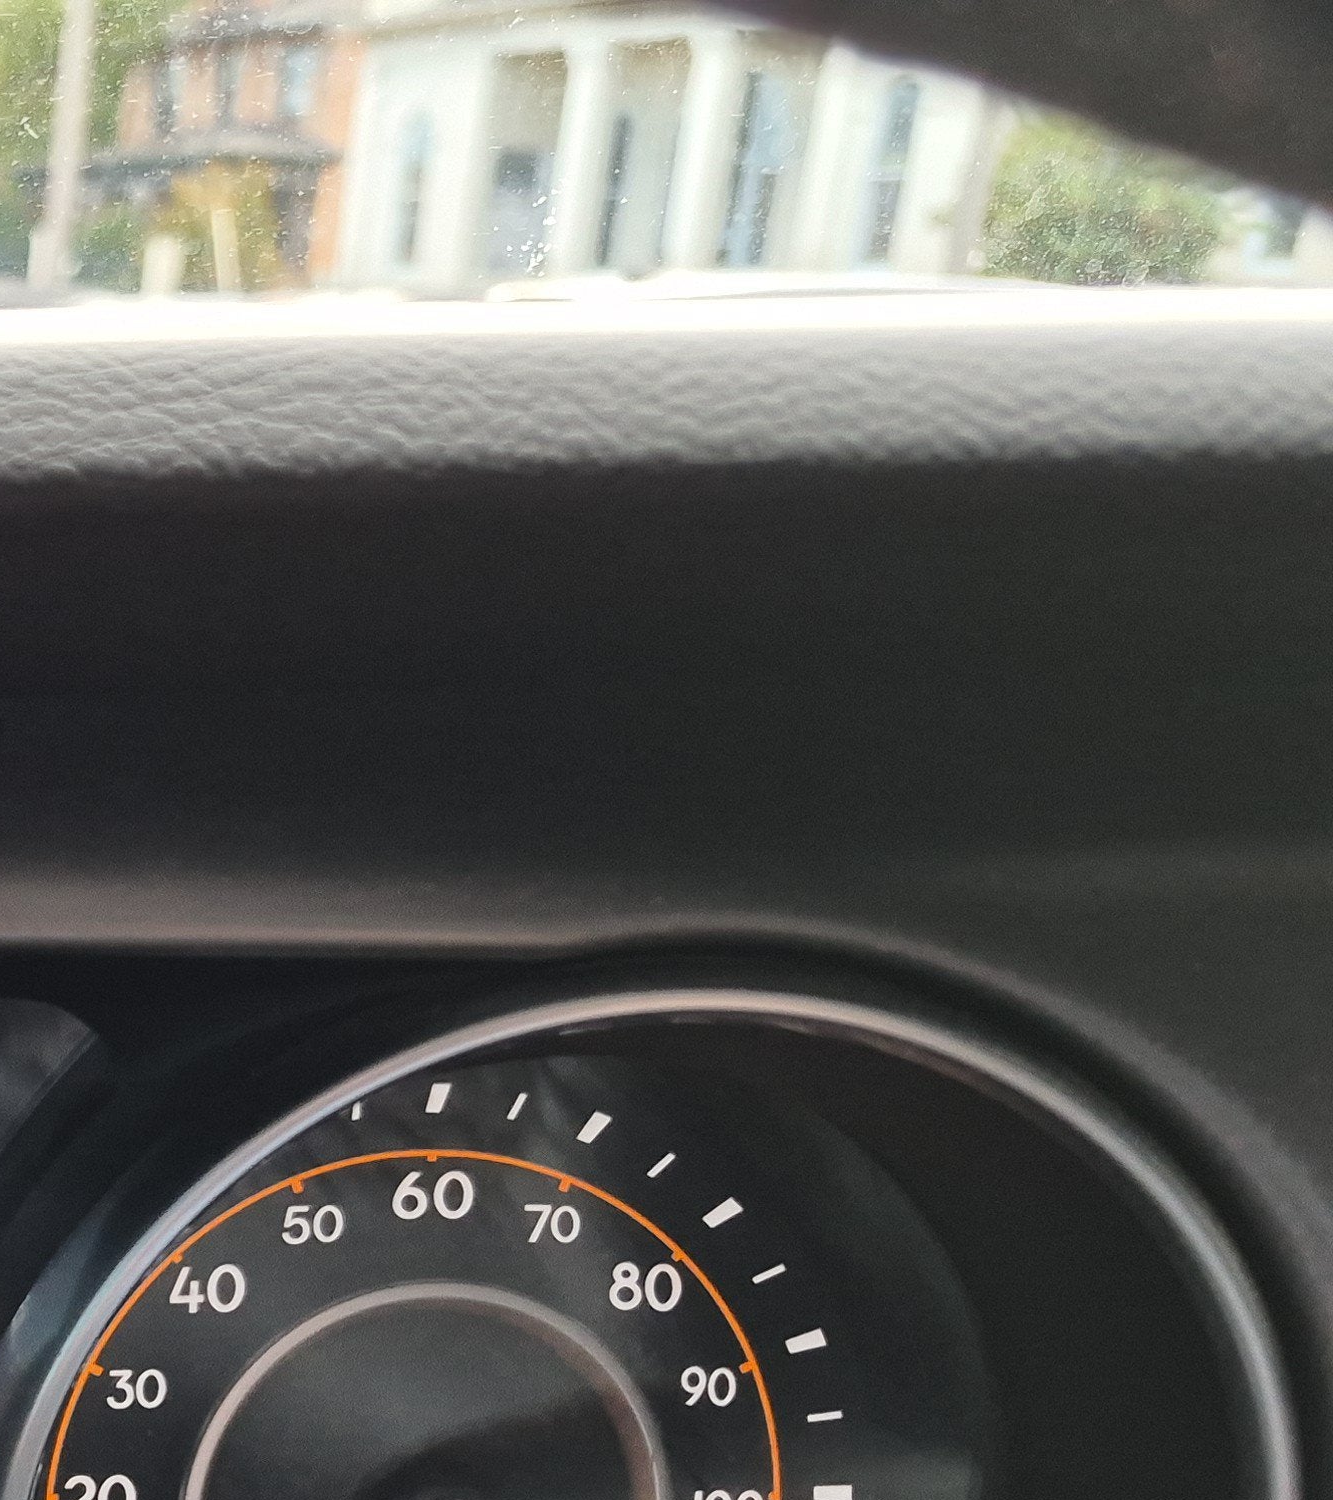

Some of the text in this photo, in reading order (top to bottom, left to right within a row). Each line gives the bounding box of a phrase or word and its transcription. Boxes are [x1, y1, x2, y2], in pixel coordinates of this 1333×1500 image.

[390, 1169, 477, 1221] 60
[280, 1203, 346, 1246] 50
[522, 1202, 582, 1245] 70
[168, 1262, 247, 1315] 40
[607, 1260, 684, 1313] 80
[105, 1367, 169, 1411] 30
[679, 1364, 738, 1408] 90
